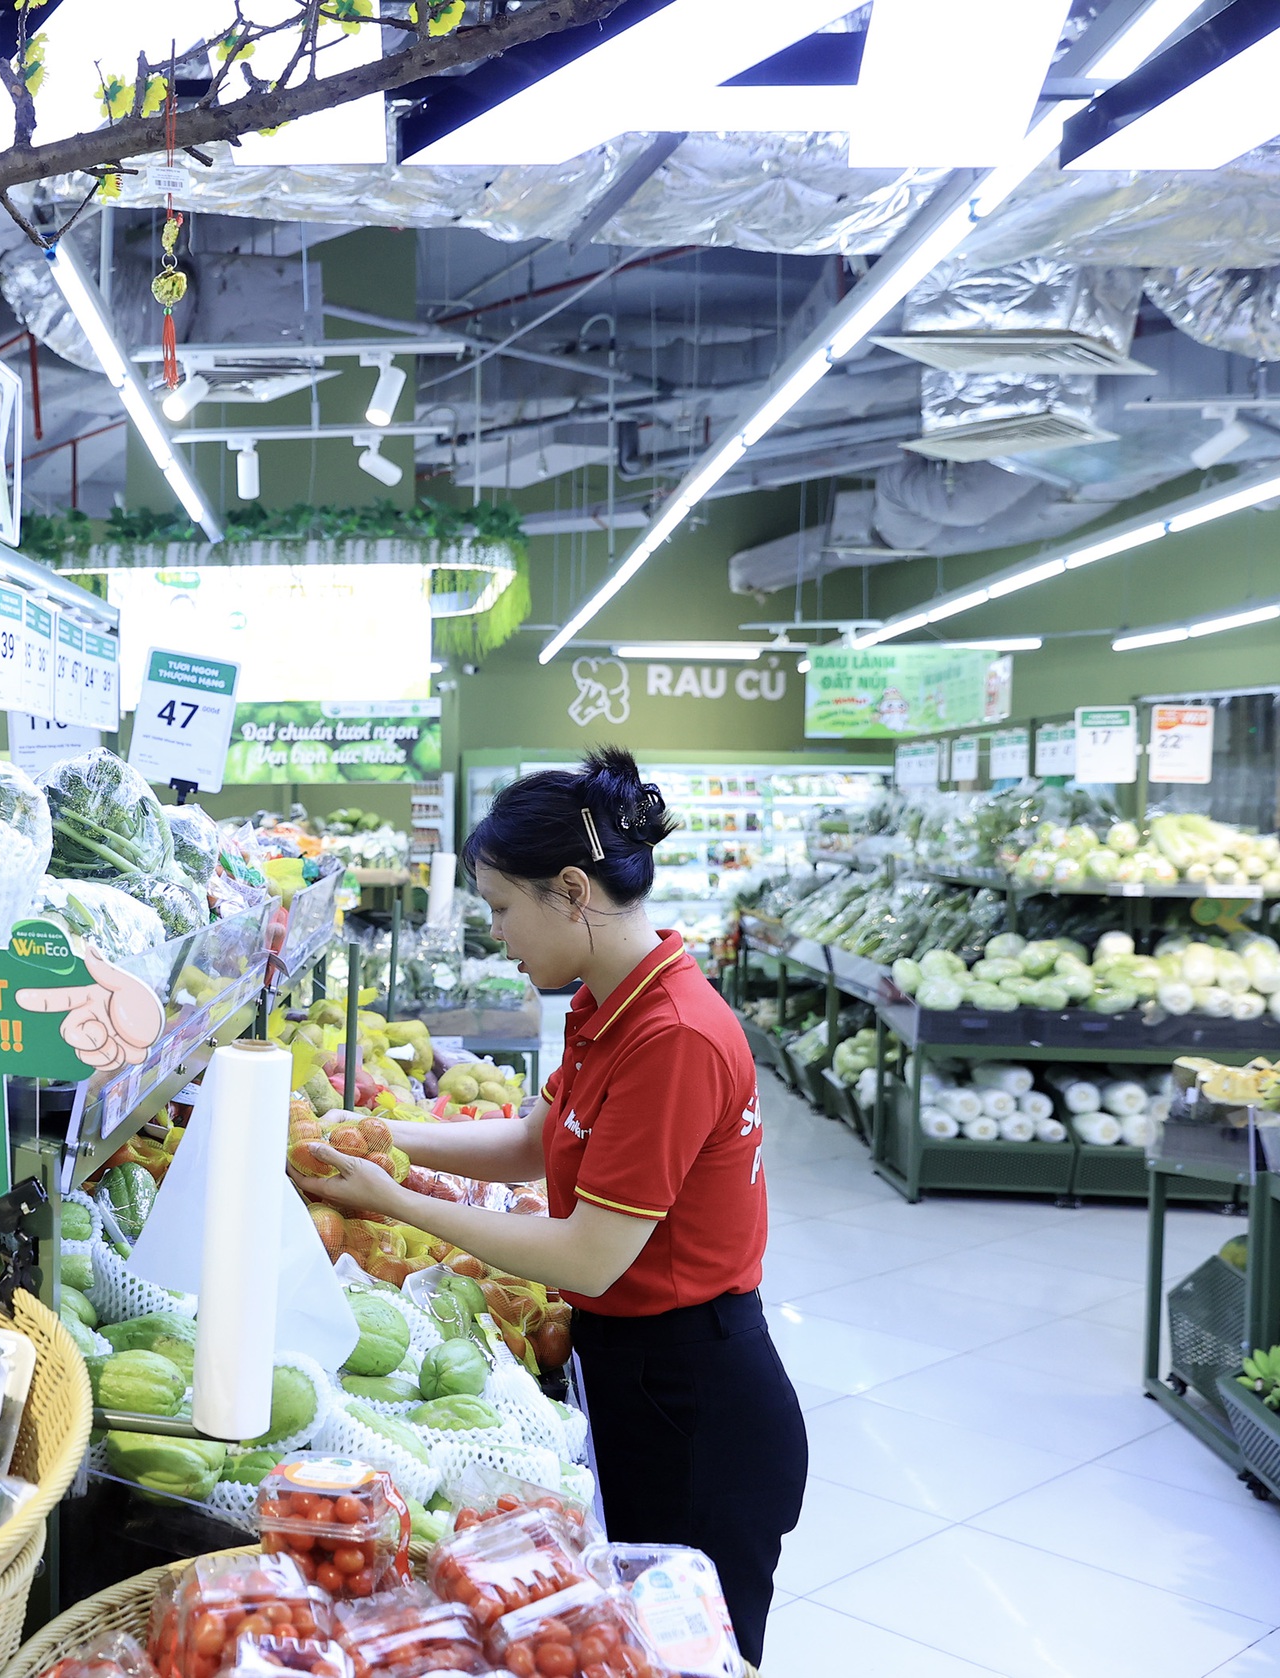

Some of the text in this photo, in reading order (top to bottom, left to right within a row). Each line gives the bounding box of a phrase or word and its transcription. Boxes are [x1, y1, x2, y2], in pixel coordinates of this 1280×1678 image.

[1, 631, 14, 659] 39
[168, 660, 219, 677] TƯƠI NGON
[815, 652, 896, 669] RAU LÀNH
[158, 669, 226, 689] THƯỢNG HẠNG
[646, 656, 786, 700] RAU CỦ
[157, 700, 199, 729] 47
[373, 724, 419, 745] ngon
[1089, 730, 1110, 745] 17
[1158, 734, 1181, 749] 22
[12, 937, 69, 957] WinEco
